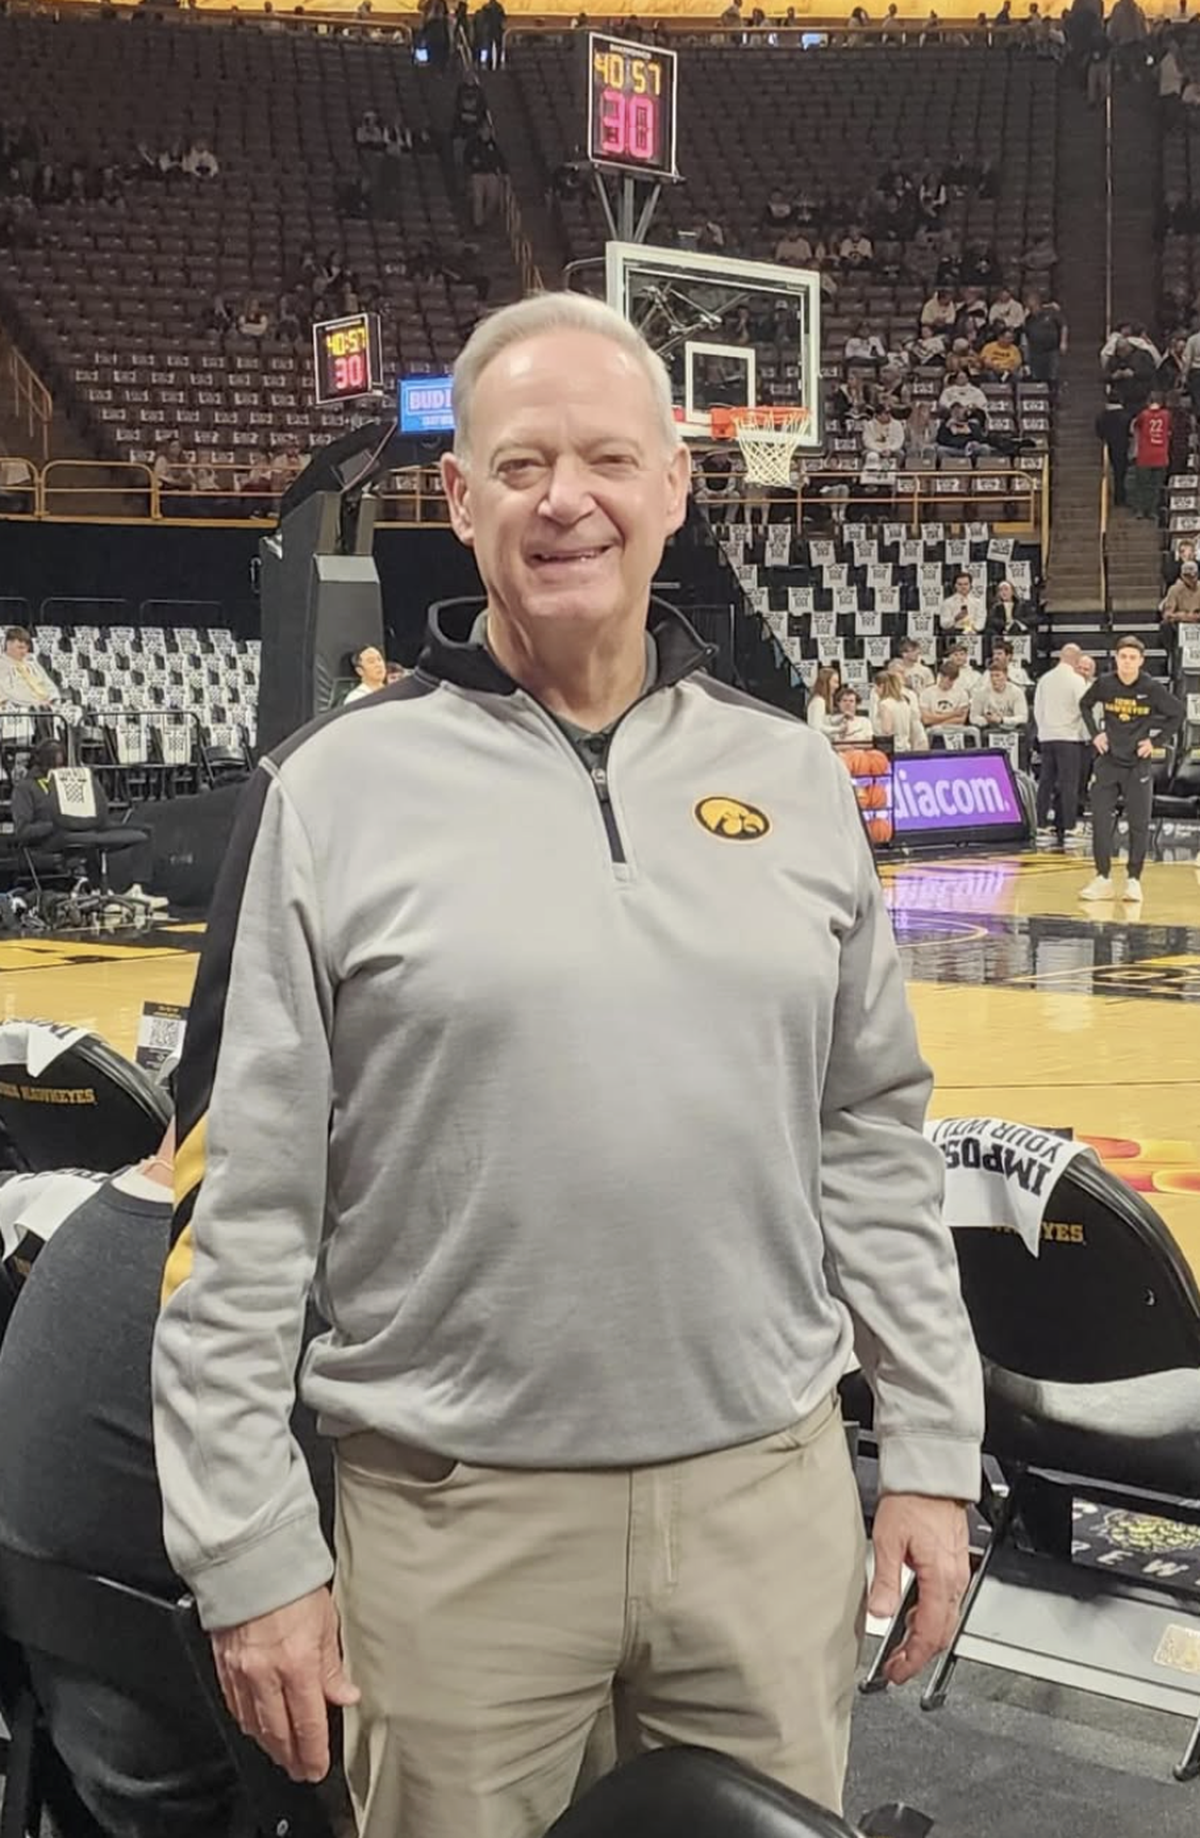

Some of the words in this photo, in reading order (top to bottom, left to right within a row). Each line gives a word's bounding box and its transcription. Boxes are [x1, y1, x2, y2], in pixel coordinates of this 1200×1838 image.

[602, 88, 654, 158] 30
[334, 355, 363, 389] 30
[1149, 419, 1163, 432] 22
[991, 1123, 1063, 1163] YOUR
[940, 1138, 1051, 1197] IMPOS
